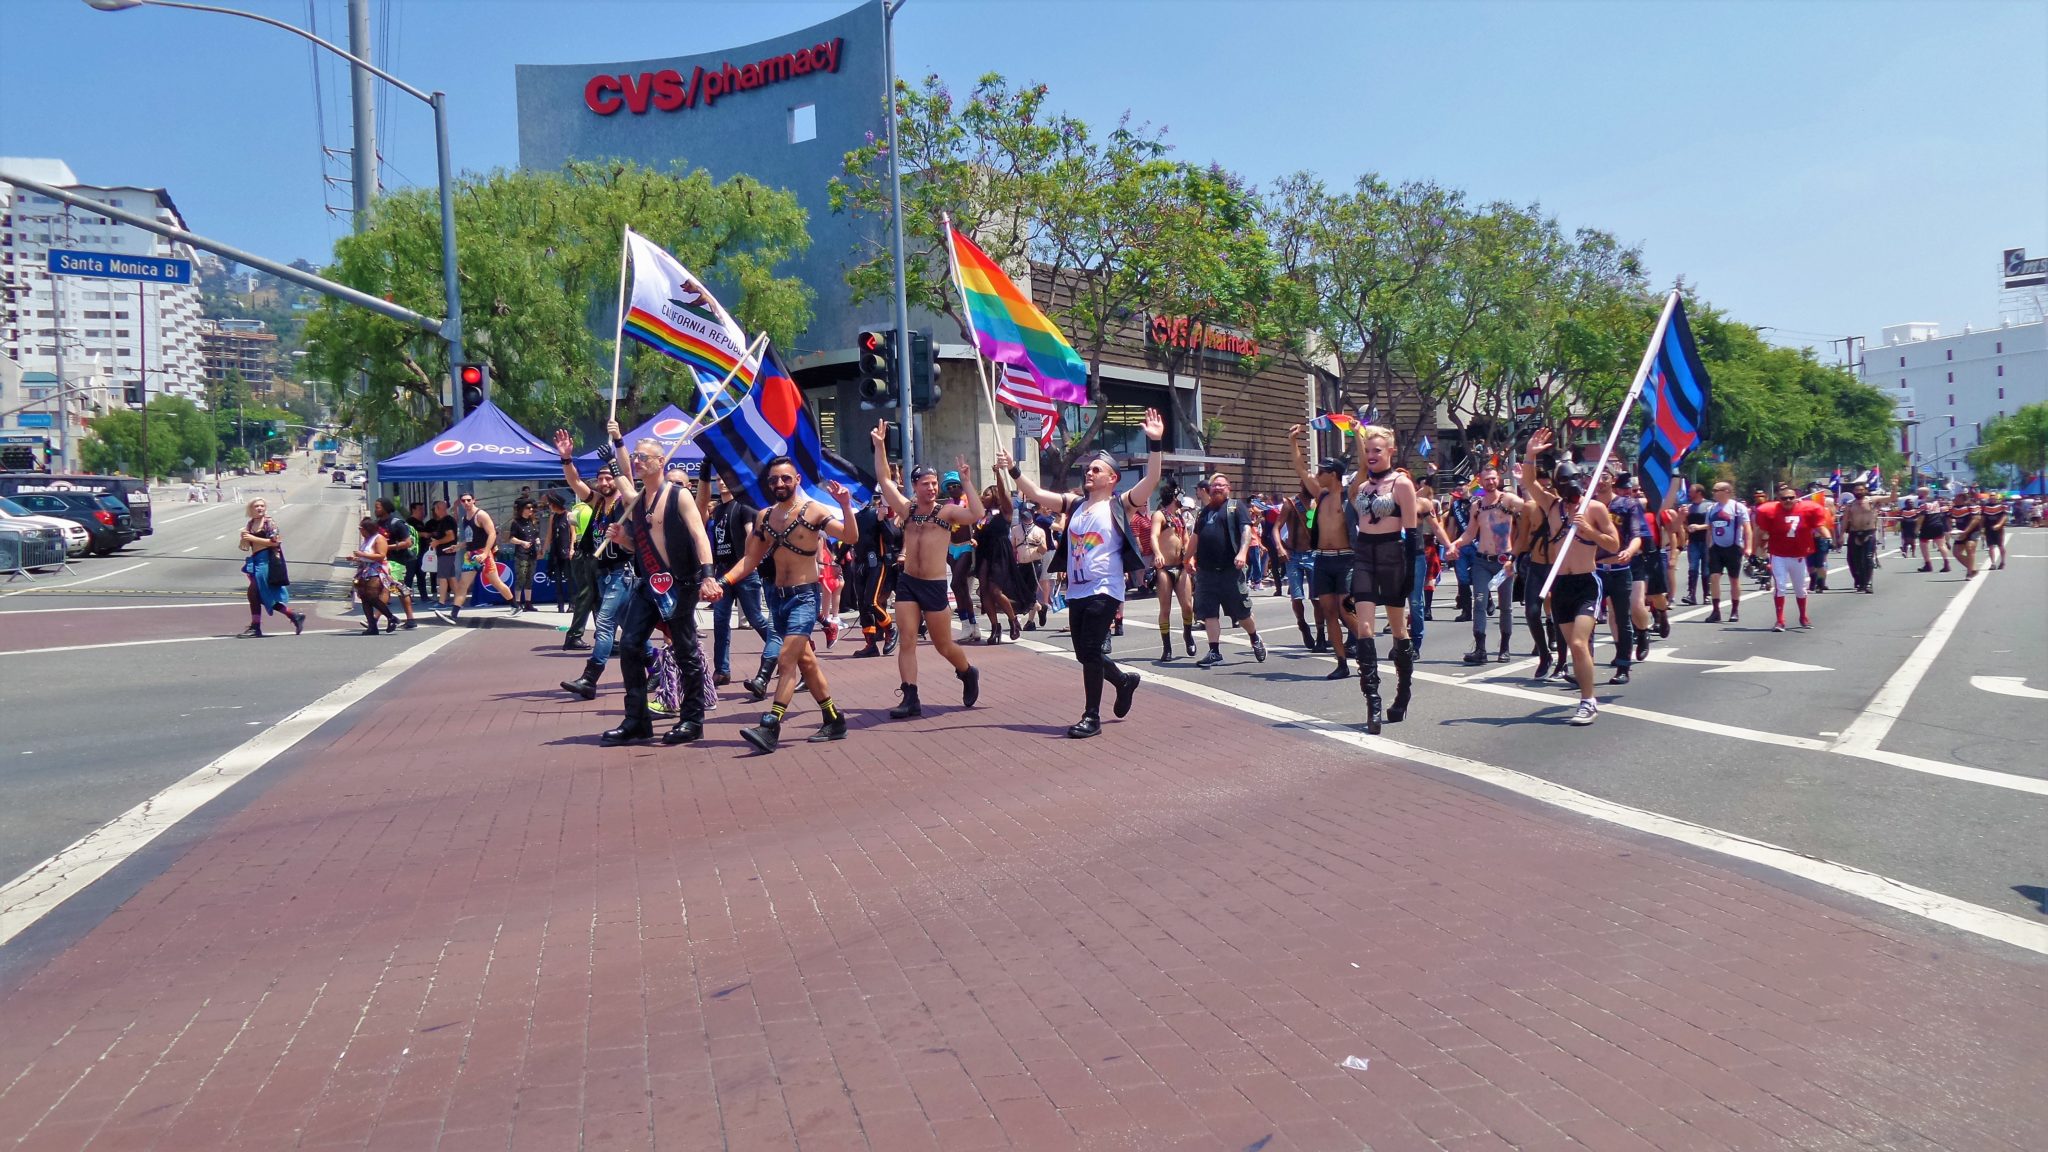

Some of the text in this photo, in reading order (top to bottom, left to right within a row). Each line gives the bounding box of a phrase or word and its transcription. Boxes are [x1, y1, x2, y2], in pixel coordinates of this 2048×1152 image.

[584, 37, 842, 115] CVS/pharmacy
[60, 255, 179, 278] Santa Monica Bl
[661, 304, 746, 358] CALIFORNIA REPUBL
[468, 443, 532, 455] pepsi
[667, 461, 702, 473] peps
[1785, 515, 1800, 537] 7
